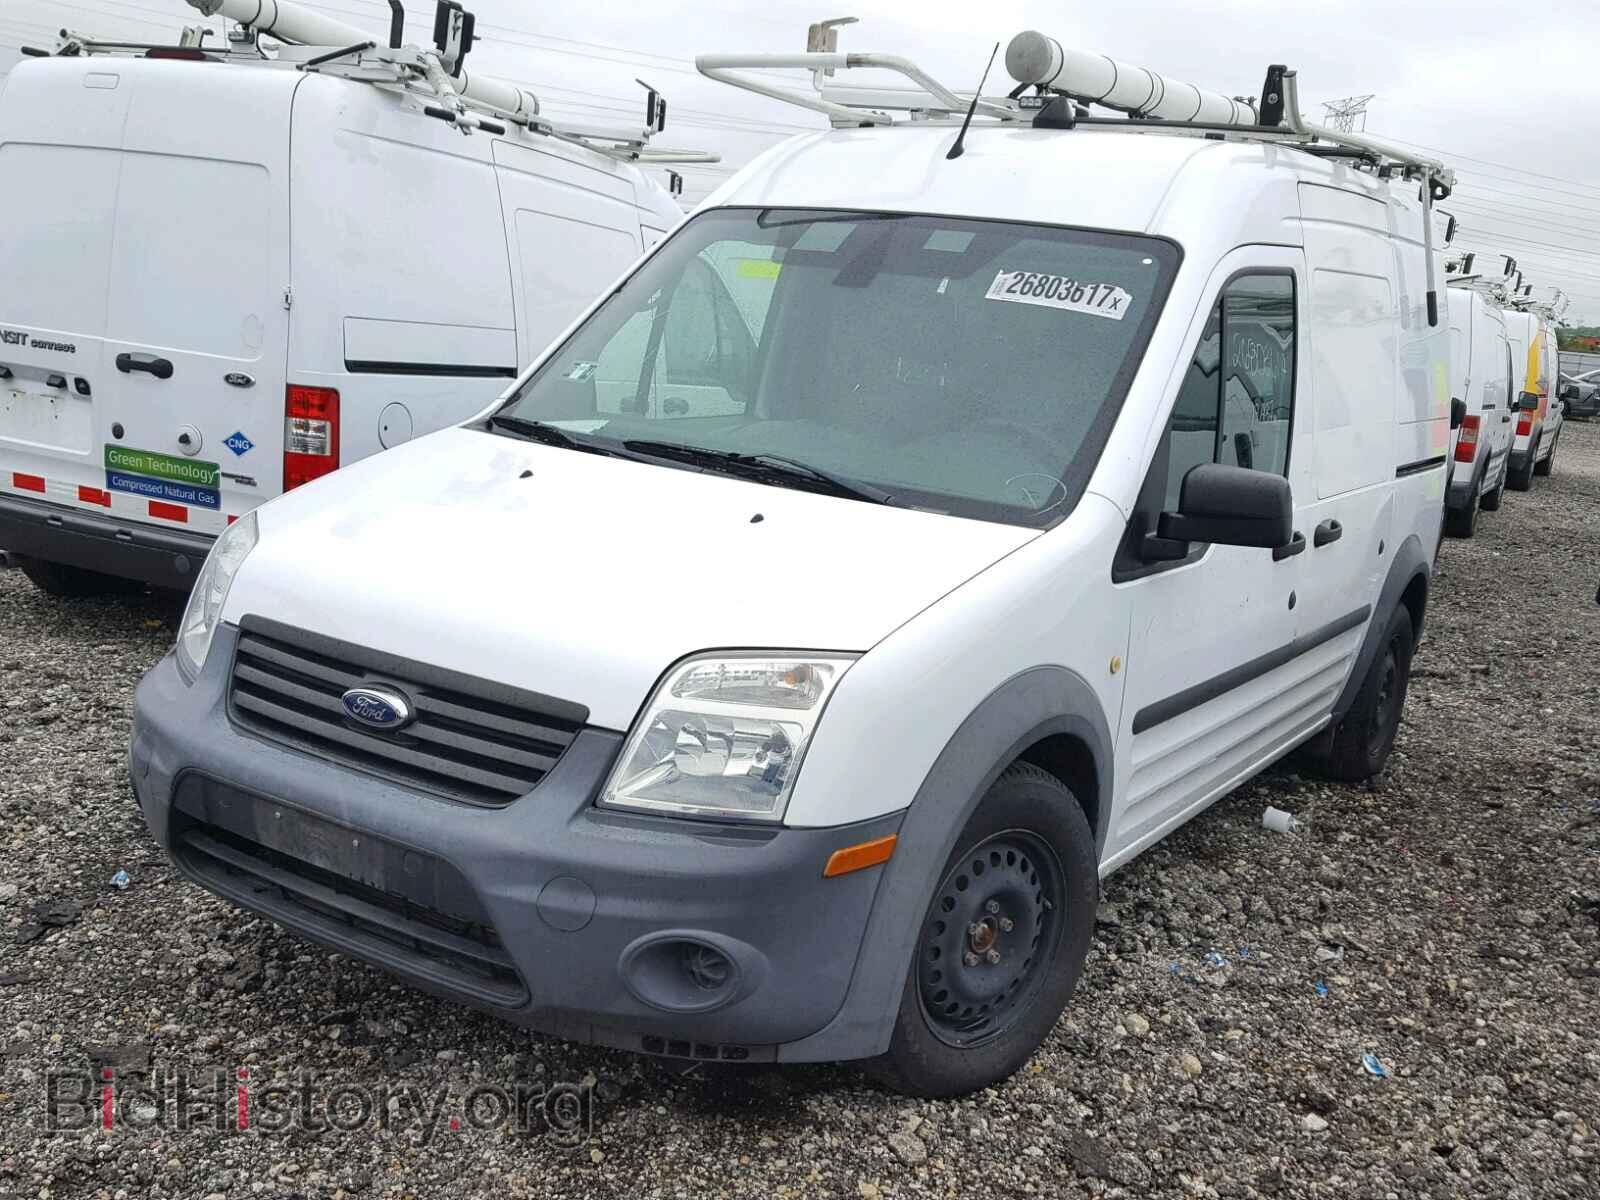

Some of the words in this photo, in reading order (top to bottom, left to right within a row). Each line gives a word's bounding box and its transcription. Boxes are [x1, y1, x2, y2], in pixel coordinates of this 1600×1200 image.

[228, 438, 249, 450] CNG
[108, 450, 143, 468] Green
[146, 457, 215, 484] Technology
[112, 475, 163, 495] Compressed
[165, 486, 196, 501] Natural
[198, 491, 215, 504] Gas
